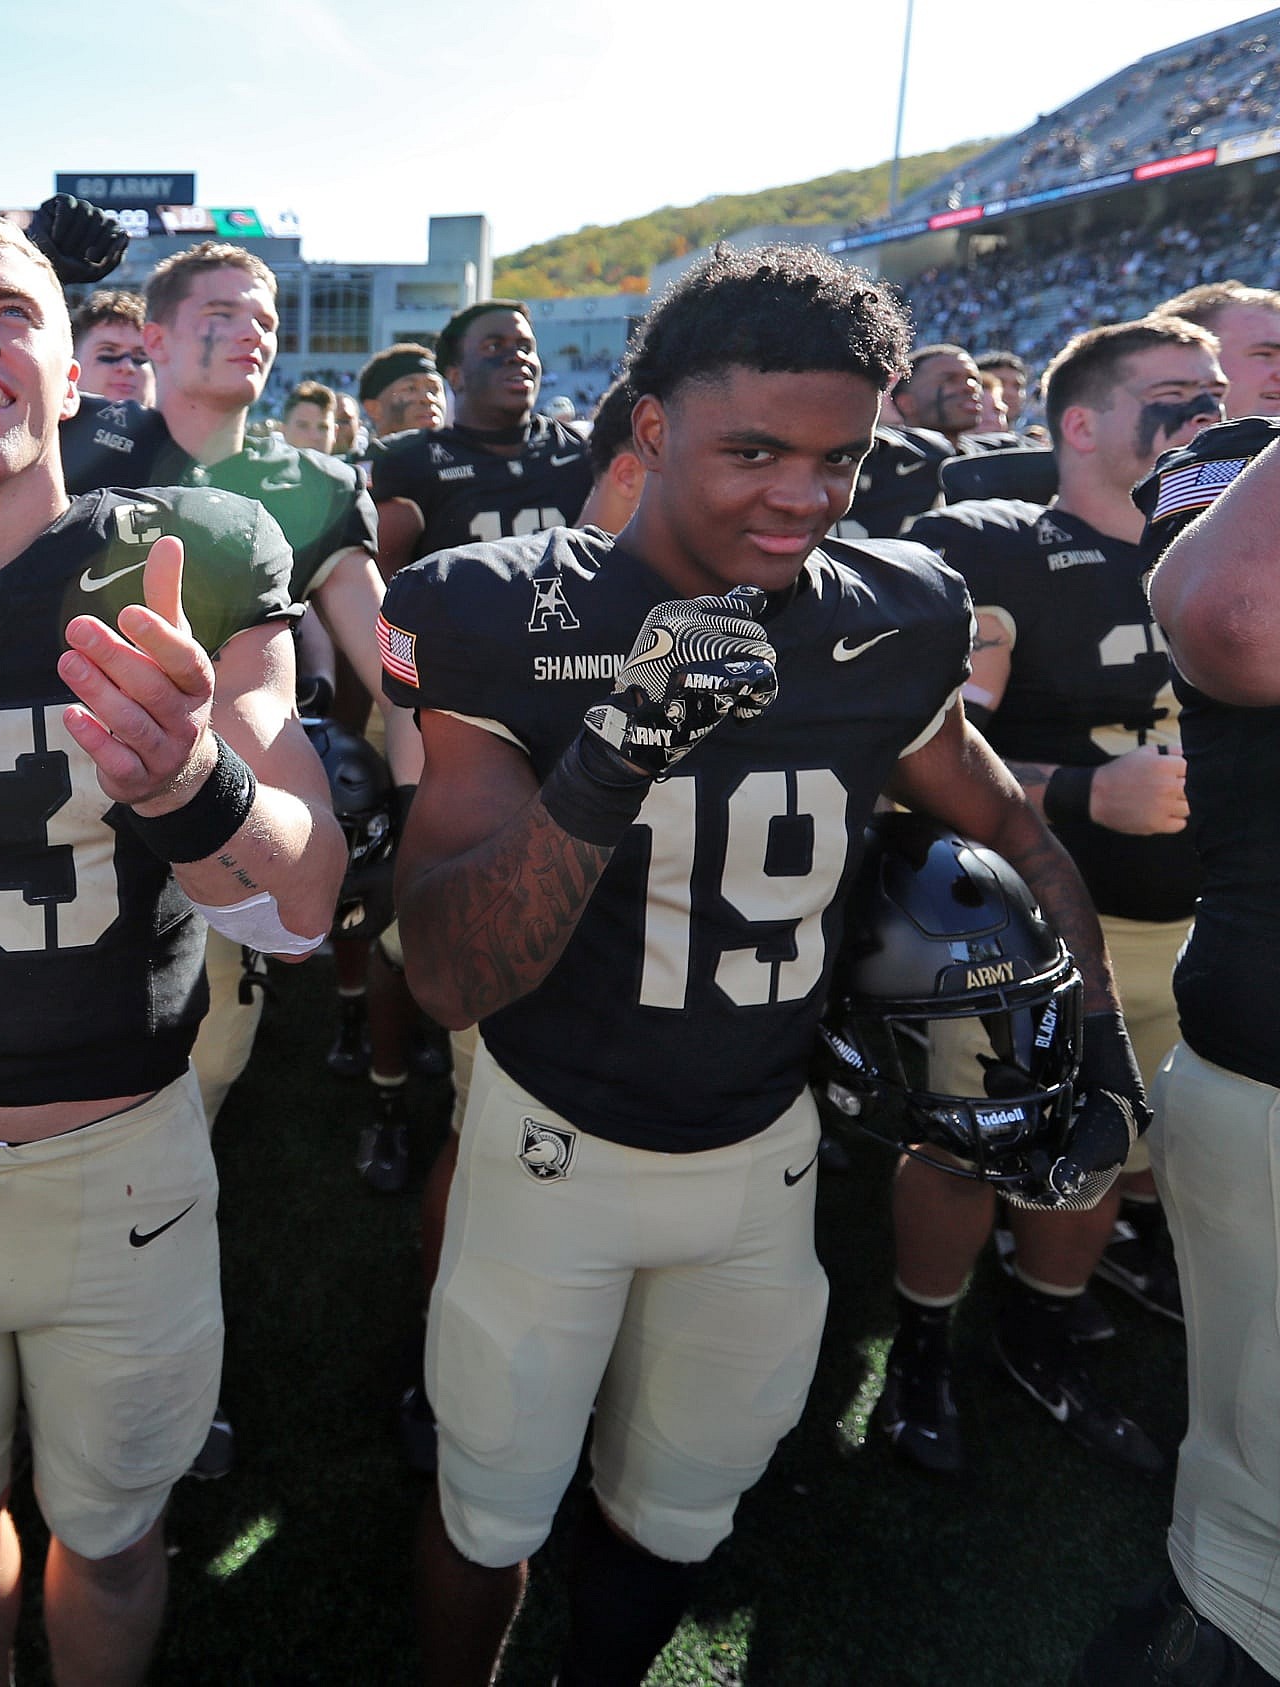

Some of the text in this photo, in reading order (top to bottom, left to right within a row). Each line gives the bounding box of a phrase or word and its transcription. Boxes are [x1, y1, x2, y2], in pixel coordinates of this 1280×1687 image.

[109, 177, 173, 199] ARMY
[93, 428, 136, 453] SAGER
[533, 653, 626, 681] SHANNON
[684, 673, 723, 690] ARMY
[689, 722, 720, 740] ARM
[631, 768, 849, 1009] 19
[966, 961, 1015, 990] ARMY
[1034, 1008, 1058, 1049] BLACK
